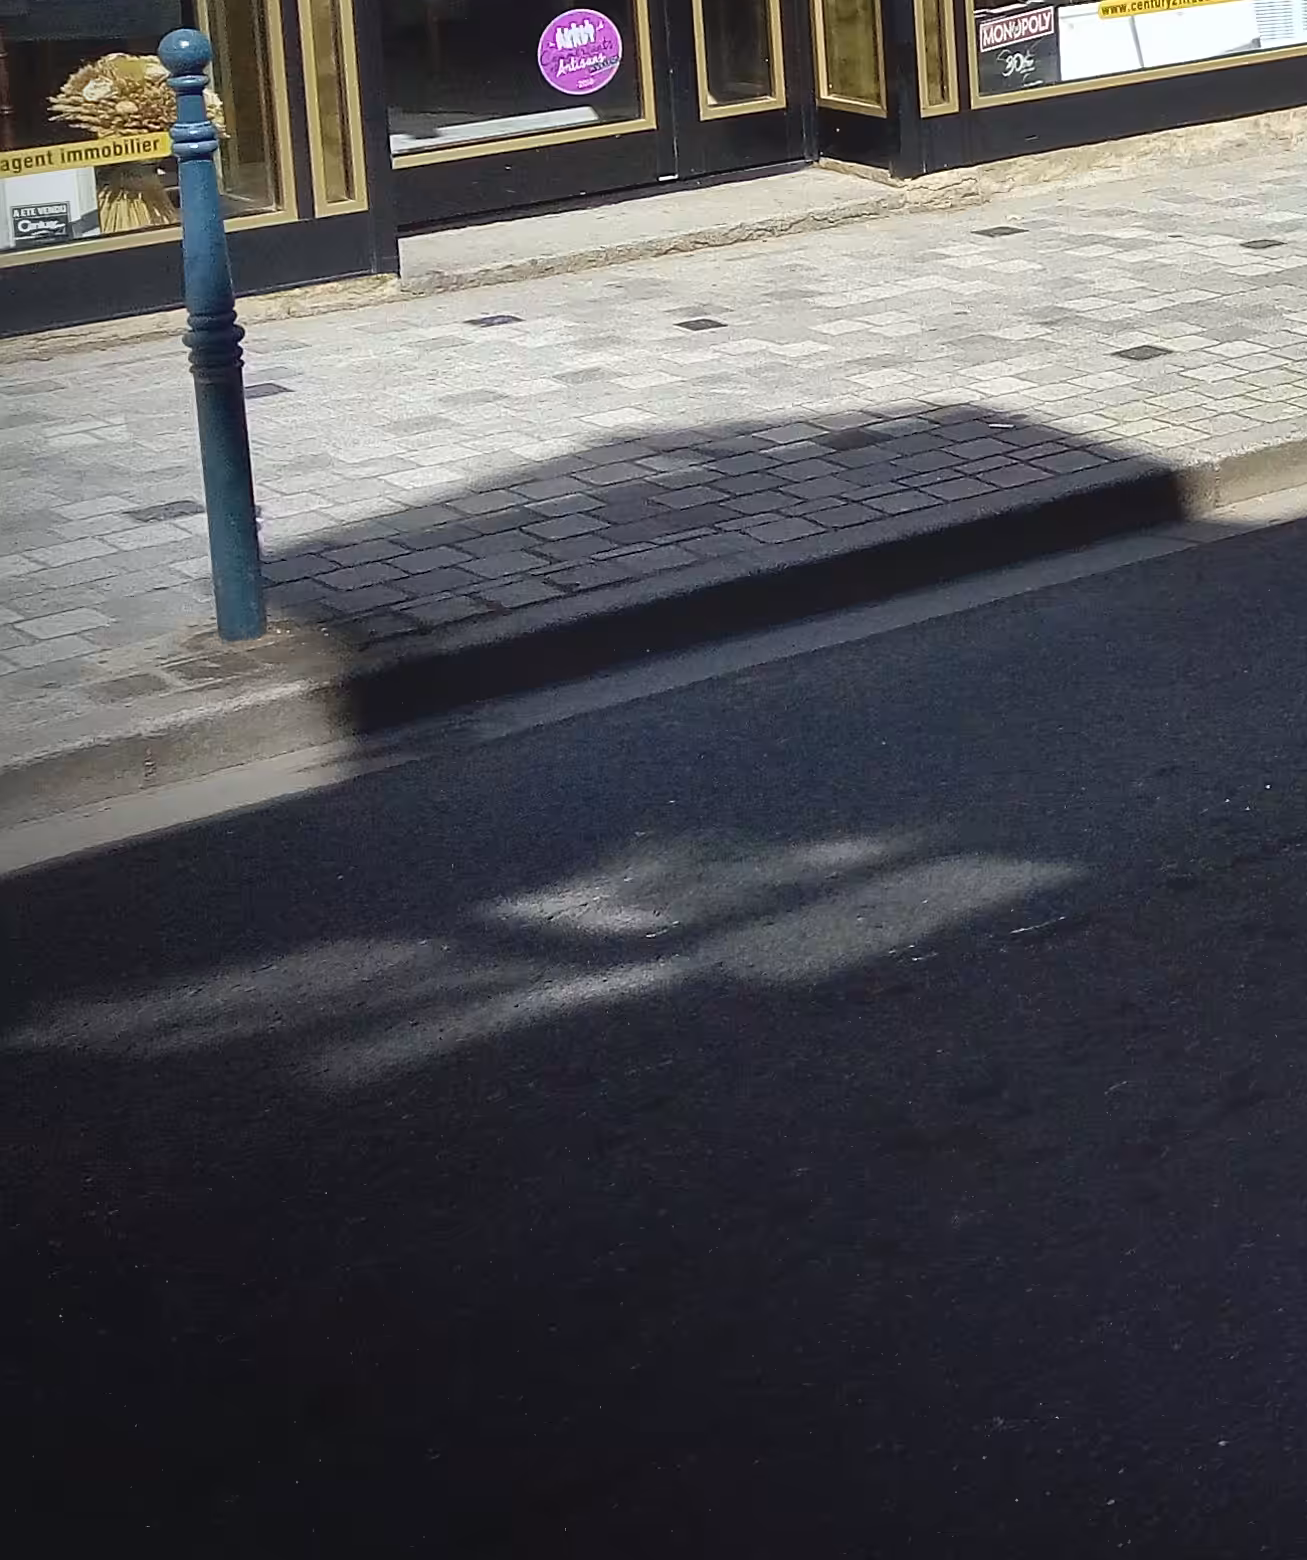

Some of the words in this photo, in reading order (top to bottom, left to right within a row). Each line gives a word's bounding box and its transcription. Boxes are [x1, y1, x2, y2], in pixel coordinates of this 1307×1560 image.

[983, 11, 1051, 47] MONOPOLY
[0, 150, 54, 174] agent
[61, 138, 160, 164] immobilier
